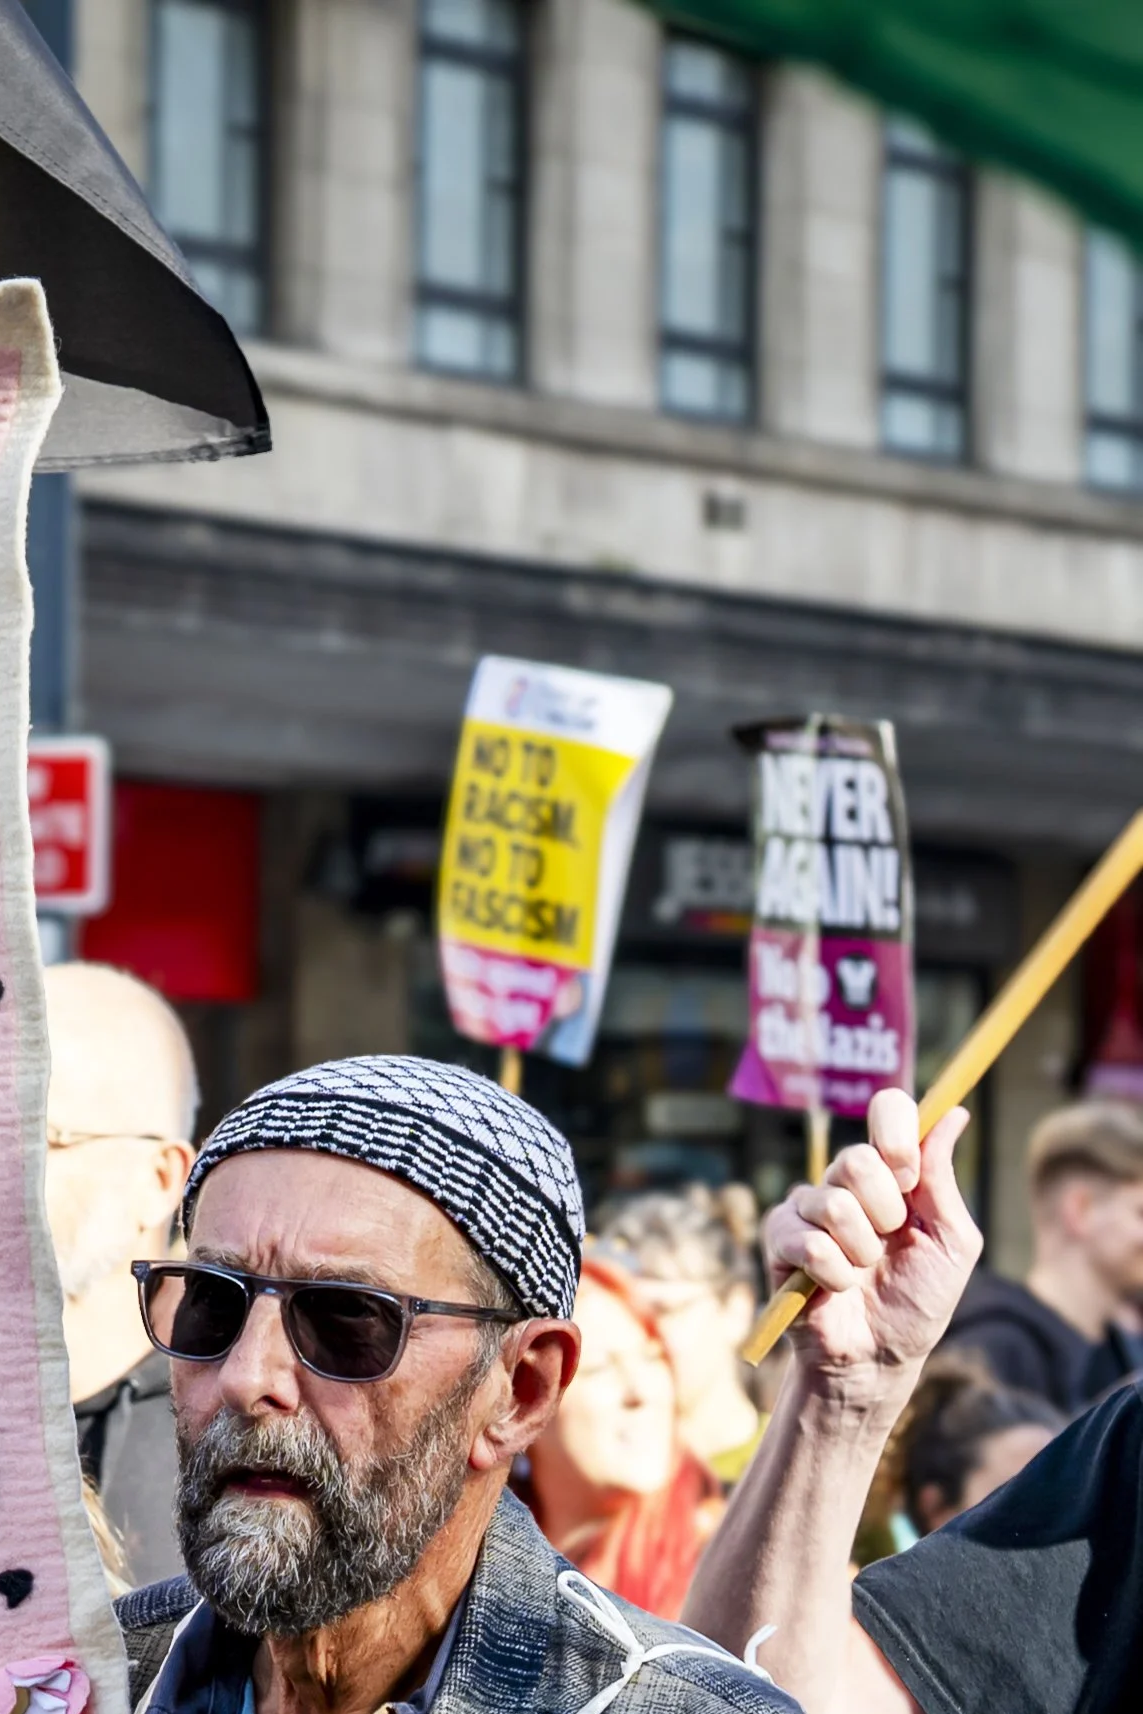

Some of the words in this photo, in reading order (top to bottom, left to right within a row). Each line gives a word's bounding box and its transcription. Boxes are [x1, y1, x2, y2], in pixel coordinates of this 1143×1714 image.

[471, 736, 511, 778] NO
[520, 741, 557, 787] TO
[759, 752, 894, 845] NEVER
[457, 835, 497, 877] NO
[510, 842, 546, 889] TO
[757, 836, 901, 931] AGAIN!
[452, 881, 581, 946] FASCISM
